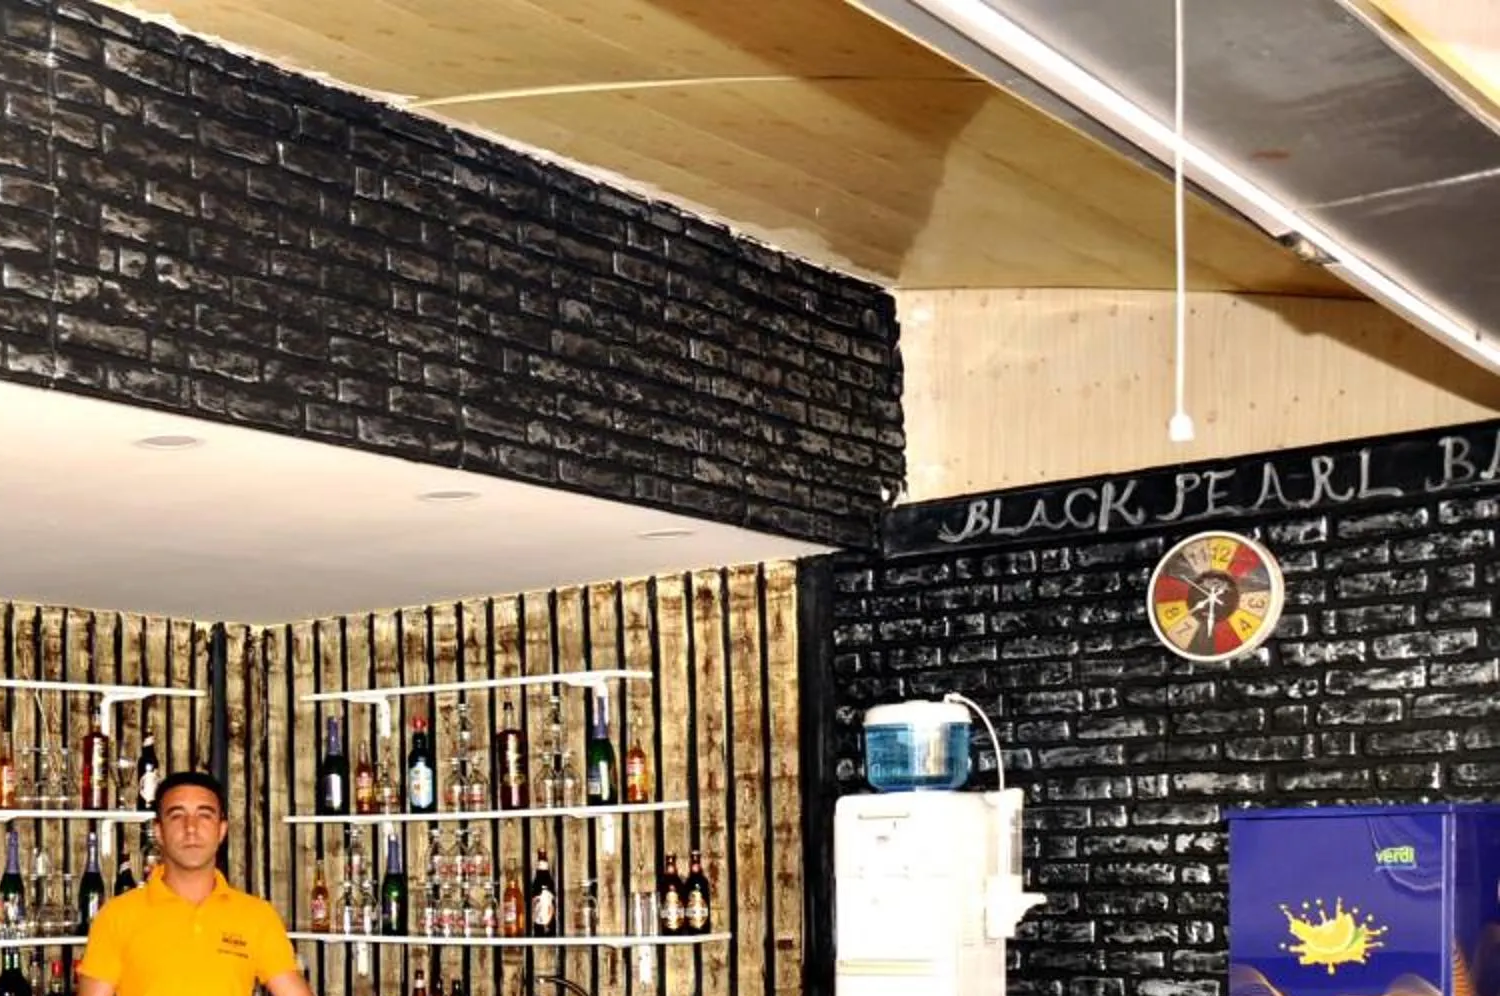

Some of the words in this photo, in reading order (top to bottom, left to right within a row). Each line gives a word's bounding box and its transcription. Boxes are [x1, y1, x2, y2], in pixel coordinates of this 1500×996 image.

[937, 480, 1146, 543] BLACK
[1156, 448, 1404, 521] PEARL
[1213, 543, 1230, 561] 12
